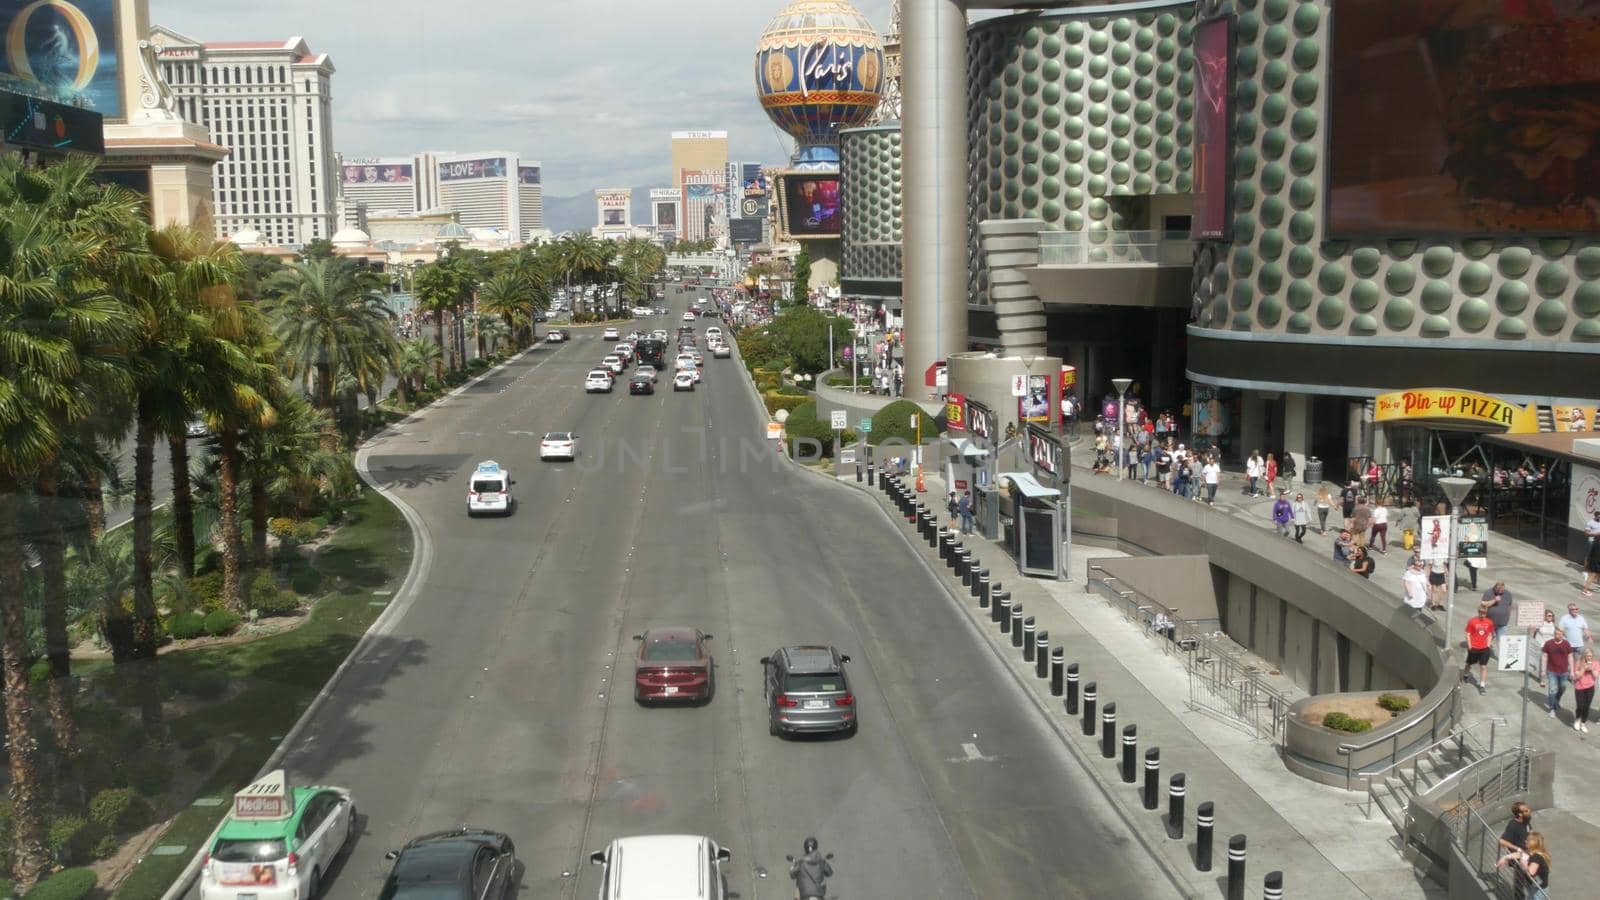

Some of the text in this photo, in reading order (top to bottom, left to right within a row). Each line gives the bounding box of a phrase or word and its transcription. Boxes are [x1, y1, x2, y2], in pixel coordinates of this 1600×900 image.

[801, 35, 851, 97] Paris
[450, 162, 474, 177] LOVE
[1402, 392, 1456, 415] Pin-up
[1460, 396, 1512, 425] PIZZA
[833, 420, 845, 428] 30
[248, 784, 280, 794] 2119
